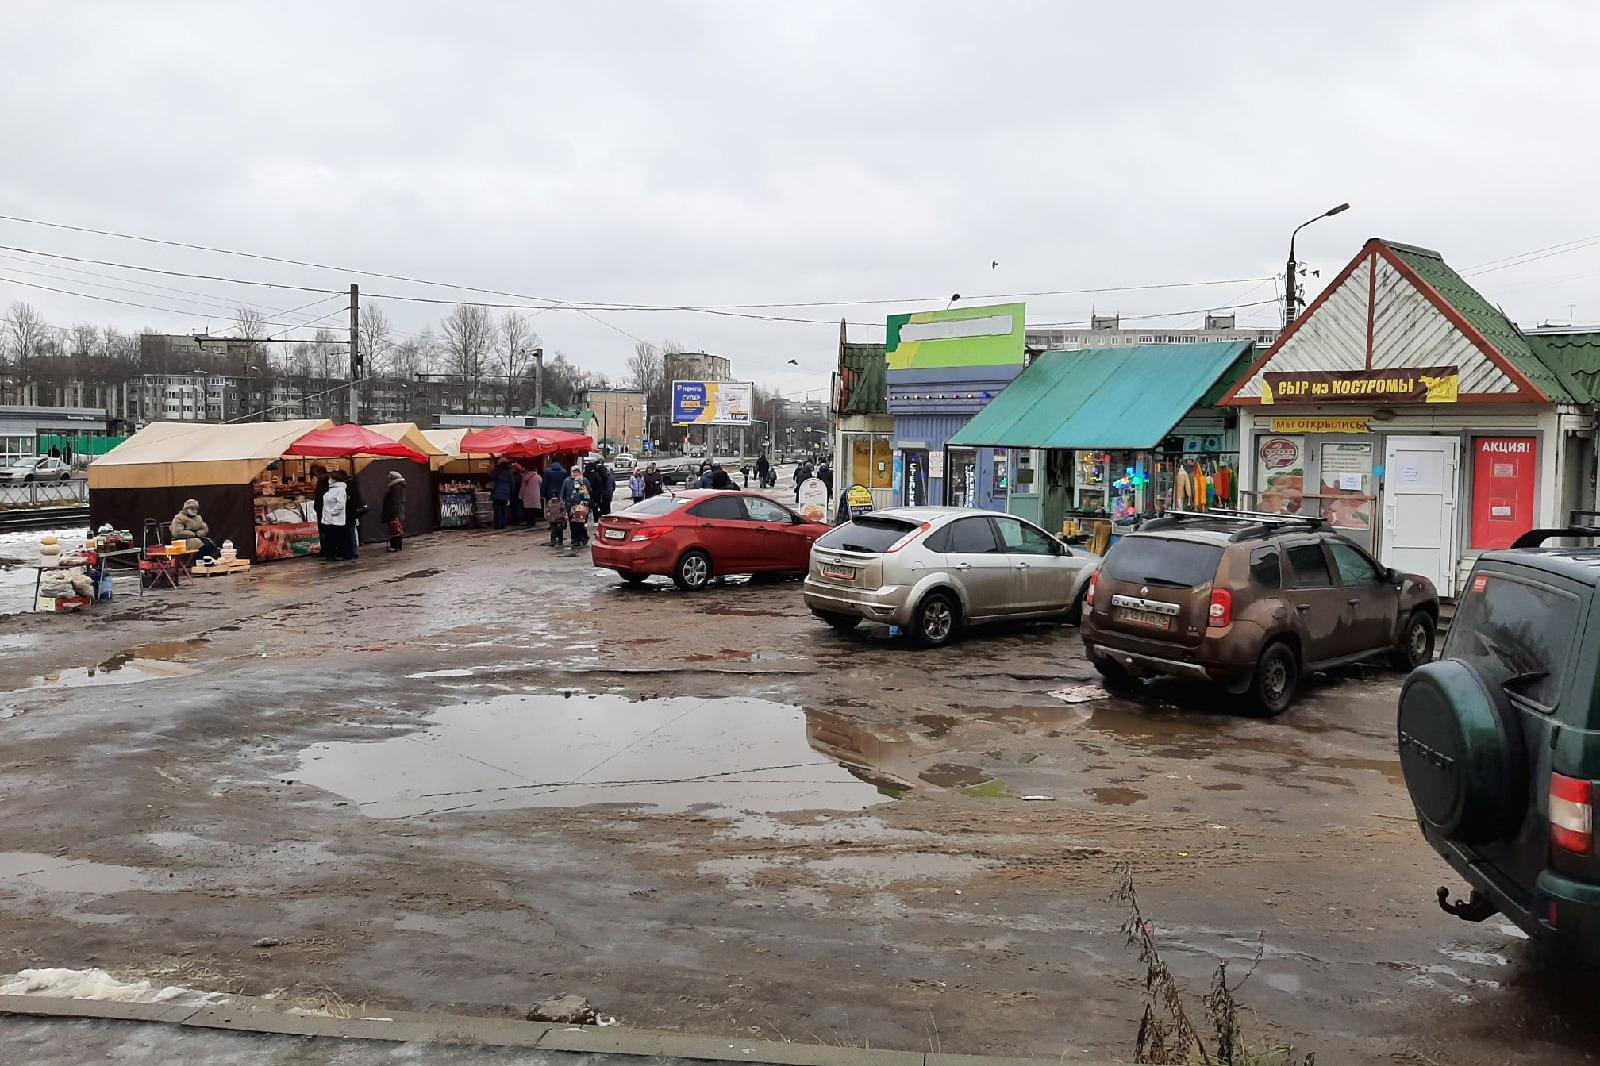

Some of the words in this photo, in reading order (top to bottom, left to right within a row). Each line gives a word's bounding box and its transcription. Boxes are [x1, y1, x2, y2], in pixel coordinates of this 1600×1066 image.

[1278, 380, 1309, 396] СЫР
[1312, 382, 1329, 395] из
[1332, 378, 1414, 394] КОСТРОМЫ
[1481, 441, 1530, 454] АКЦИЯ!
